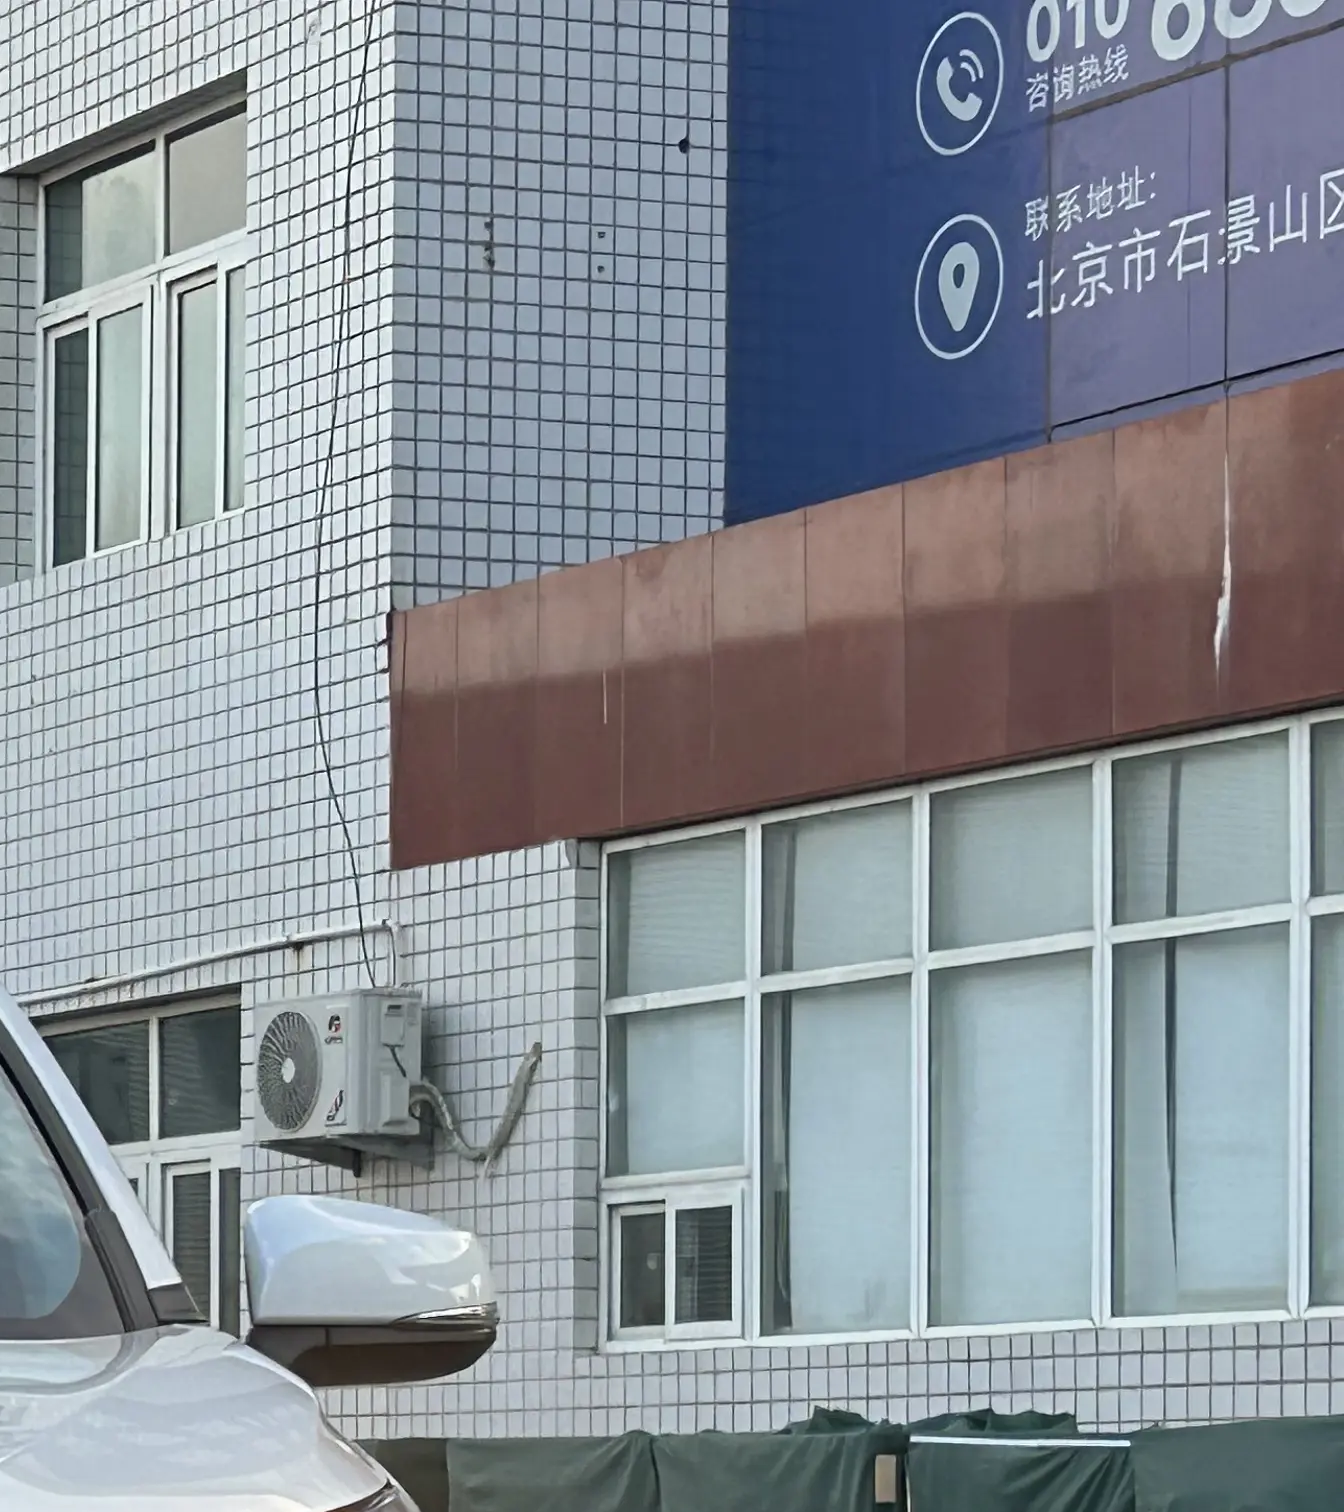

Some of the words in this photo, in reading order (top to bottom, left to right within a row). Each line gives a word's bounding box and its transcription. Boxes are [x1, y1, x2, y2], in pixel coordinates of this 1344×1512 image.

[1026, 44, 1129, 112] 咨询热线
[1026, 168, 1344, 318] 北京市石景山区
